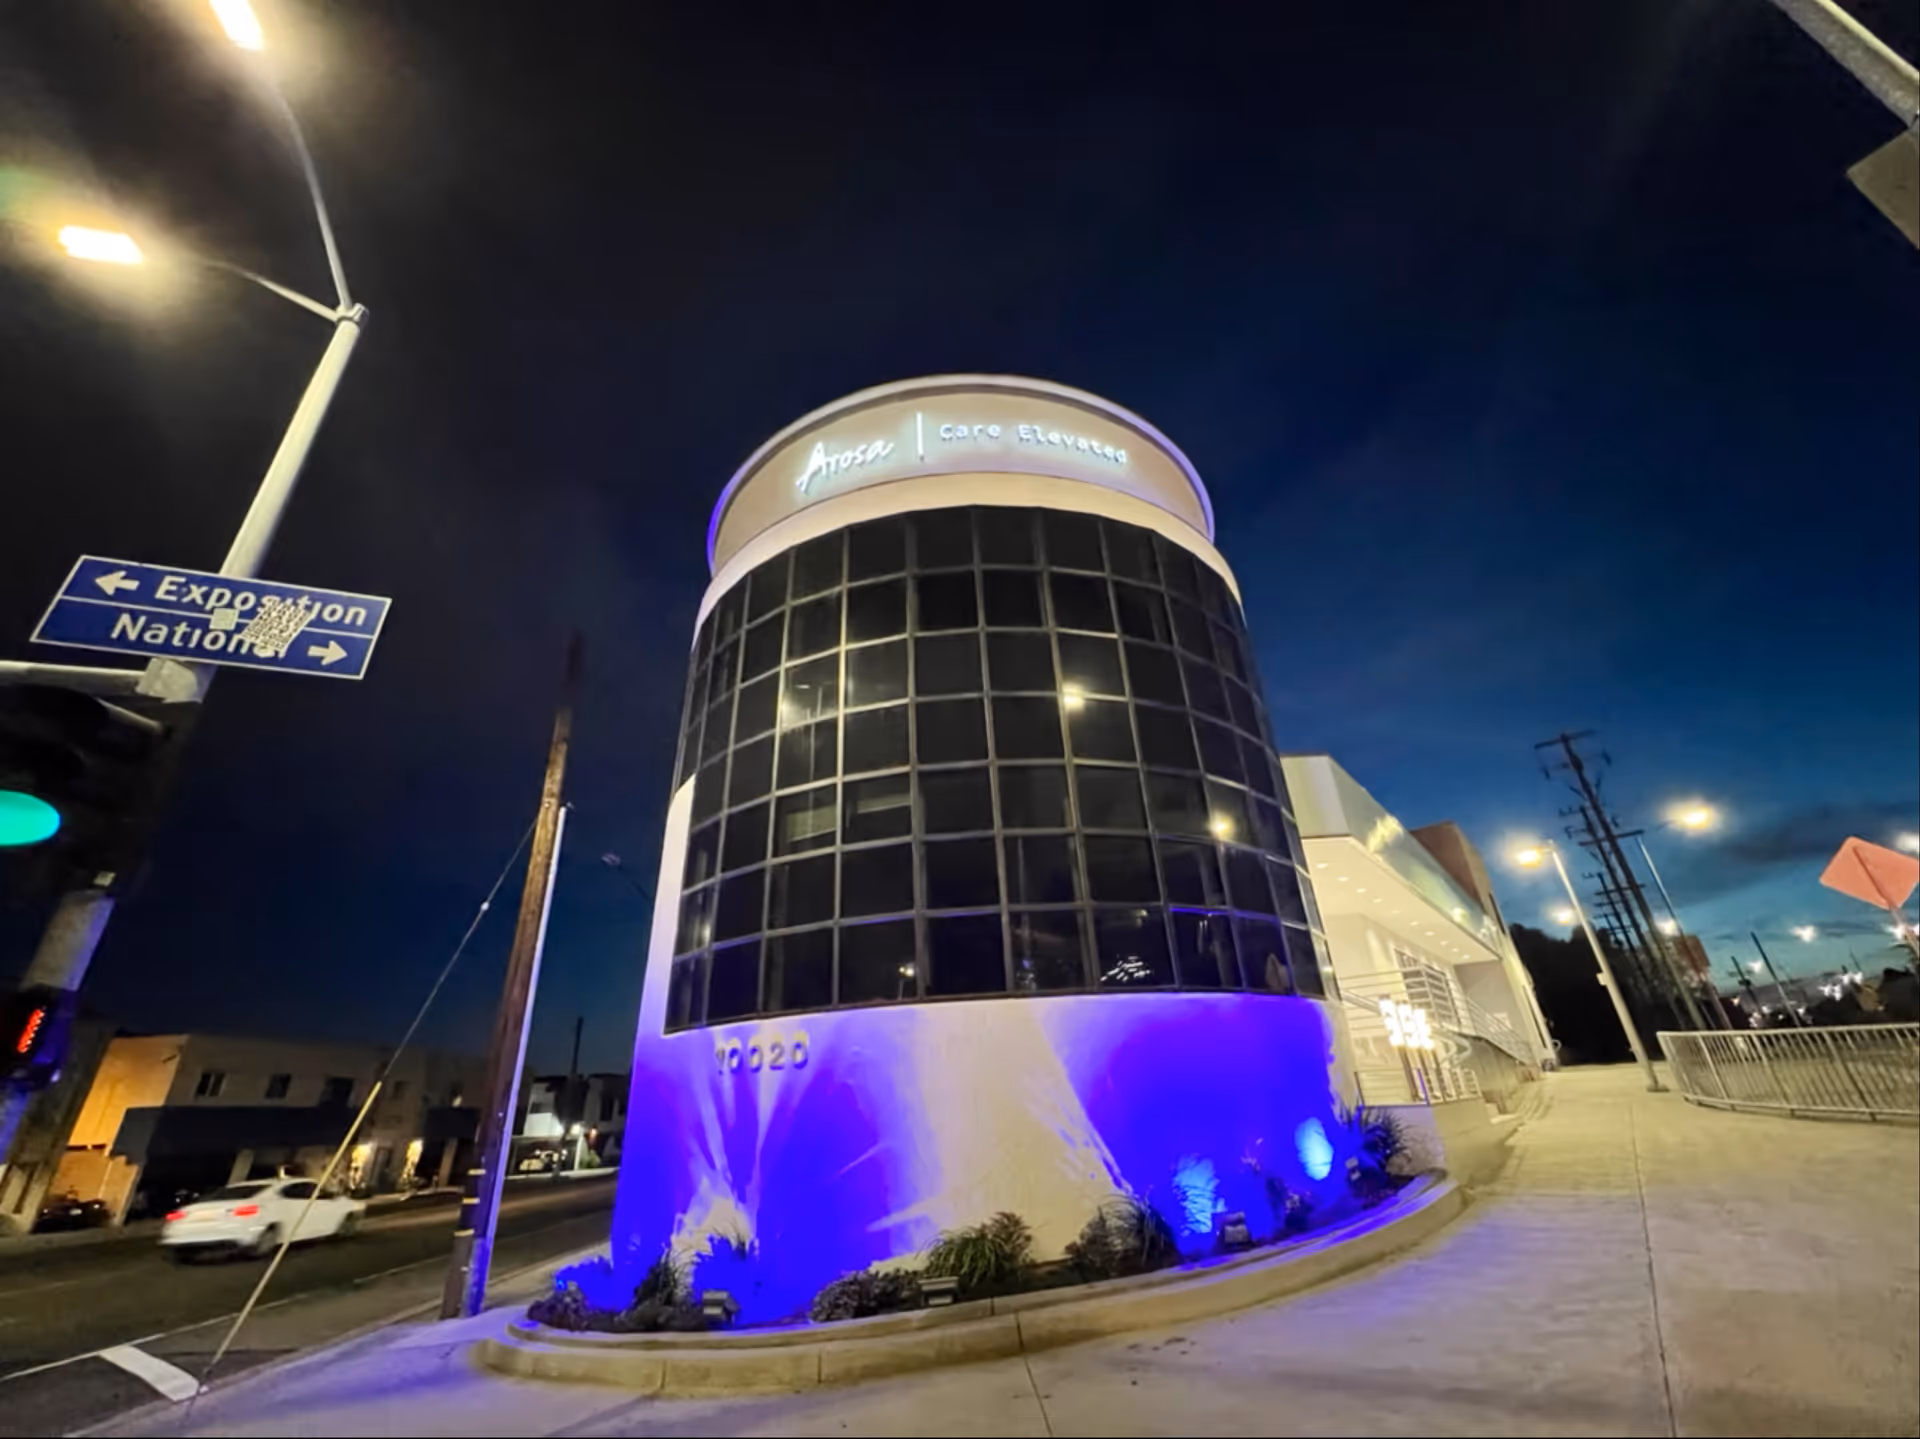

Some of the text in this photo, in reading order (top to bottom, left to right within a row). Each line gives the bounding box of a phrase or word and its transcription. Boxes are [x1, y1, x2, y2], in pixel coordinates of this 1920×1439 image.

[939, 422, 1126, 463] Care Elevated
[796, 441, 894, 493] Arosa
[154, 575, 367, 626] Expostion
[715, 1030, 809, 1075] 10020
